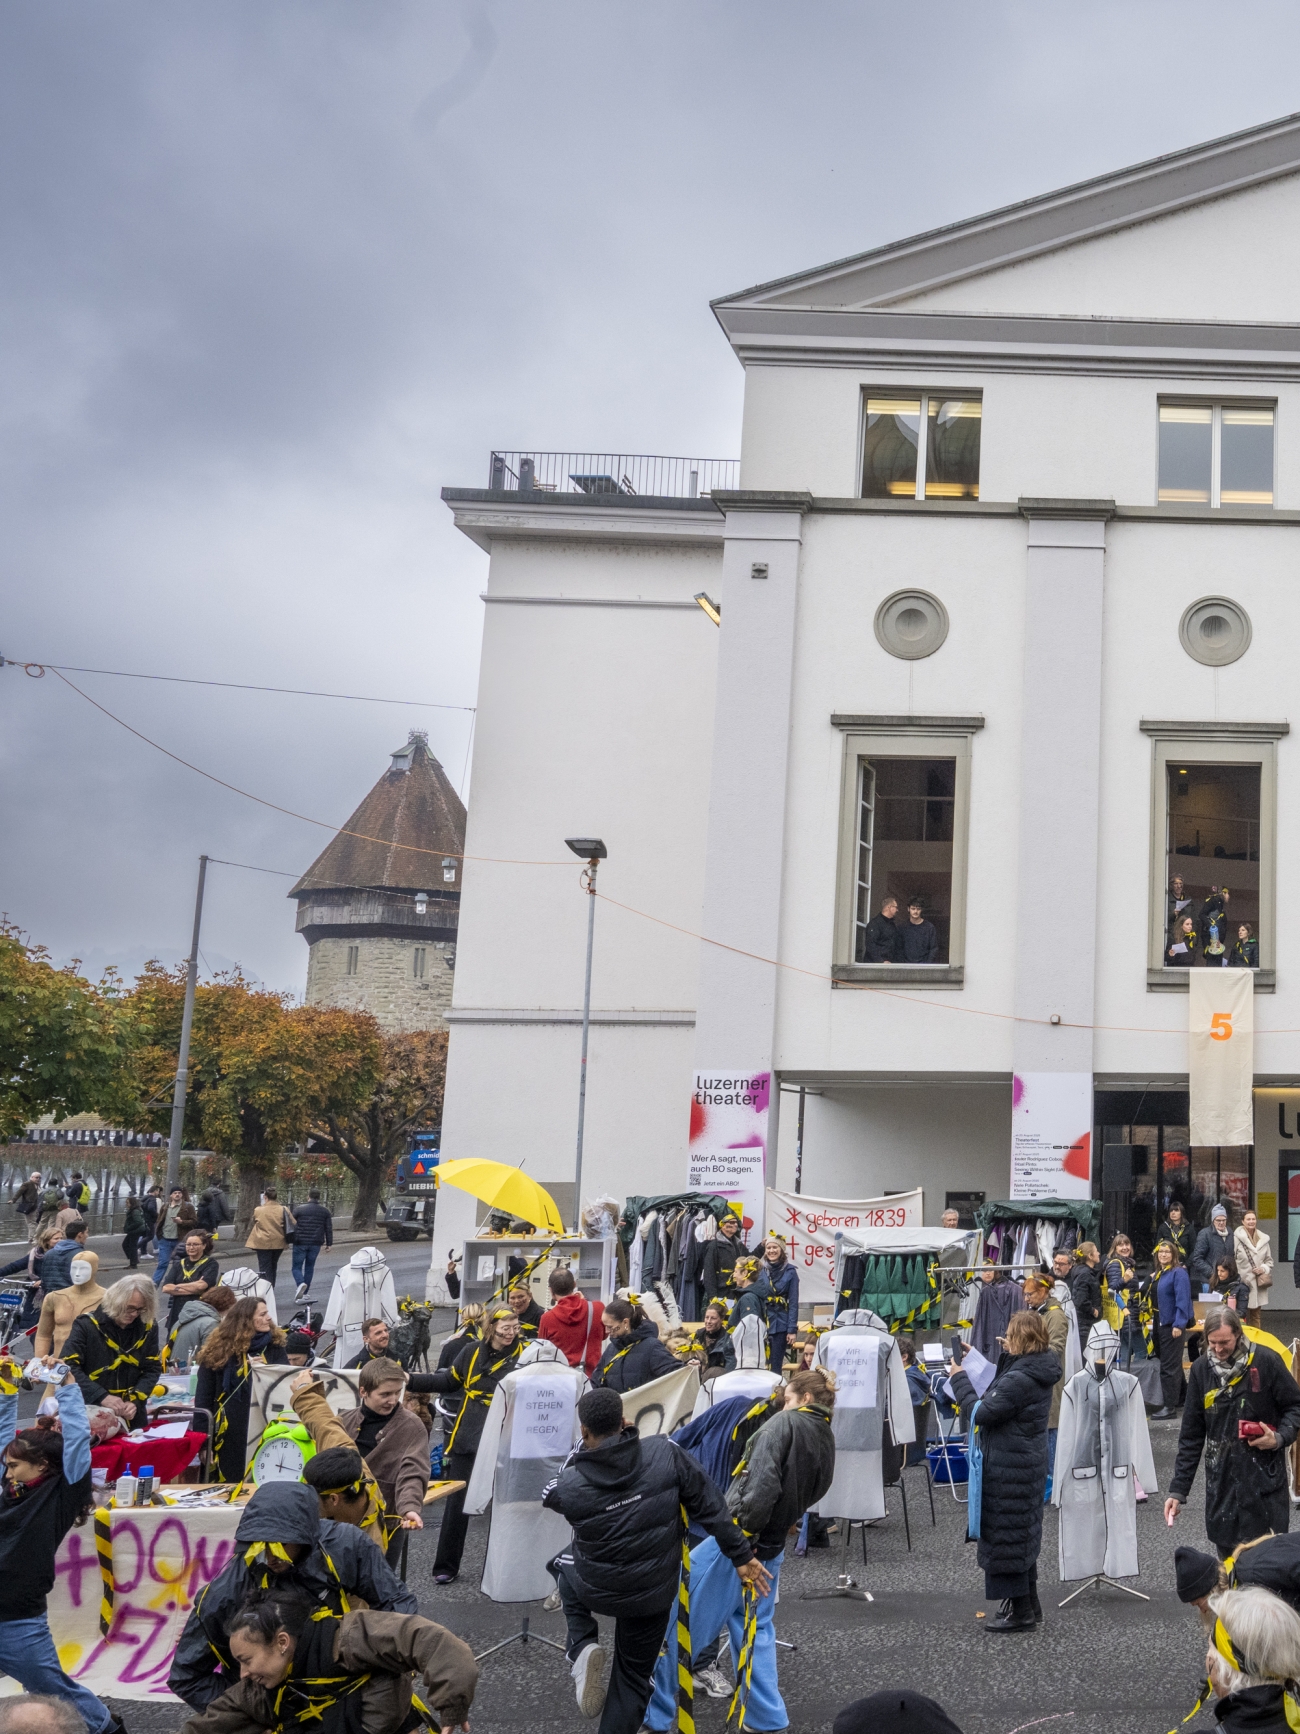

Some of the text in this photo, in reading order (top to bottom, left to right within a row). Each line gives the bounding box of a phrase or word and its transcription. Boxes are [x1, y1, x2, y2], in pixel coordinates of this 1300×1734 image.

[1210, 1013, 1232, 1041] 5
[697, 1076, 767, 1090] luzerner
[695, 1091, 759, 1105] theater
[718, 1155, 738, 1164] sagt,
[690, 1165, 710, 1173] auch
[727, 1166, 753, 1174] sagen.
[806, 1208, 906, 1234] geboren 1839
[838, 1379, 865, 1387] REGEN
[536, 1389, 555, 1398] WIR
[525, 1401, 564, 1410] STEHEN
[537, 1413, 549, 1421] IM
[525, 1425, 559, 1434] REGEN
[605, 1502, 621, 1511] HELLY
